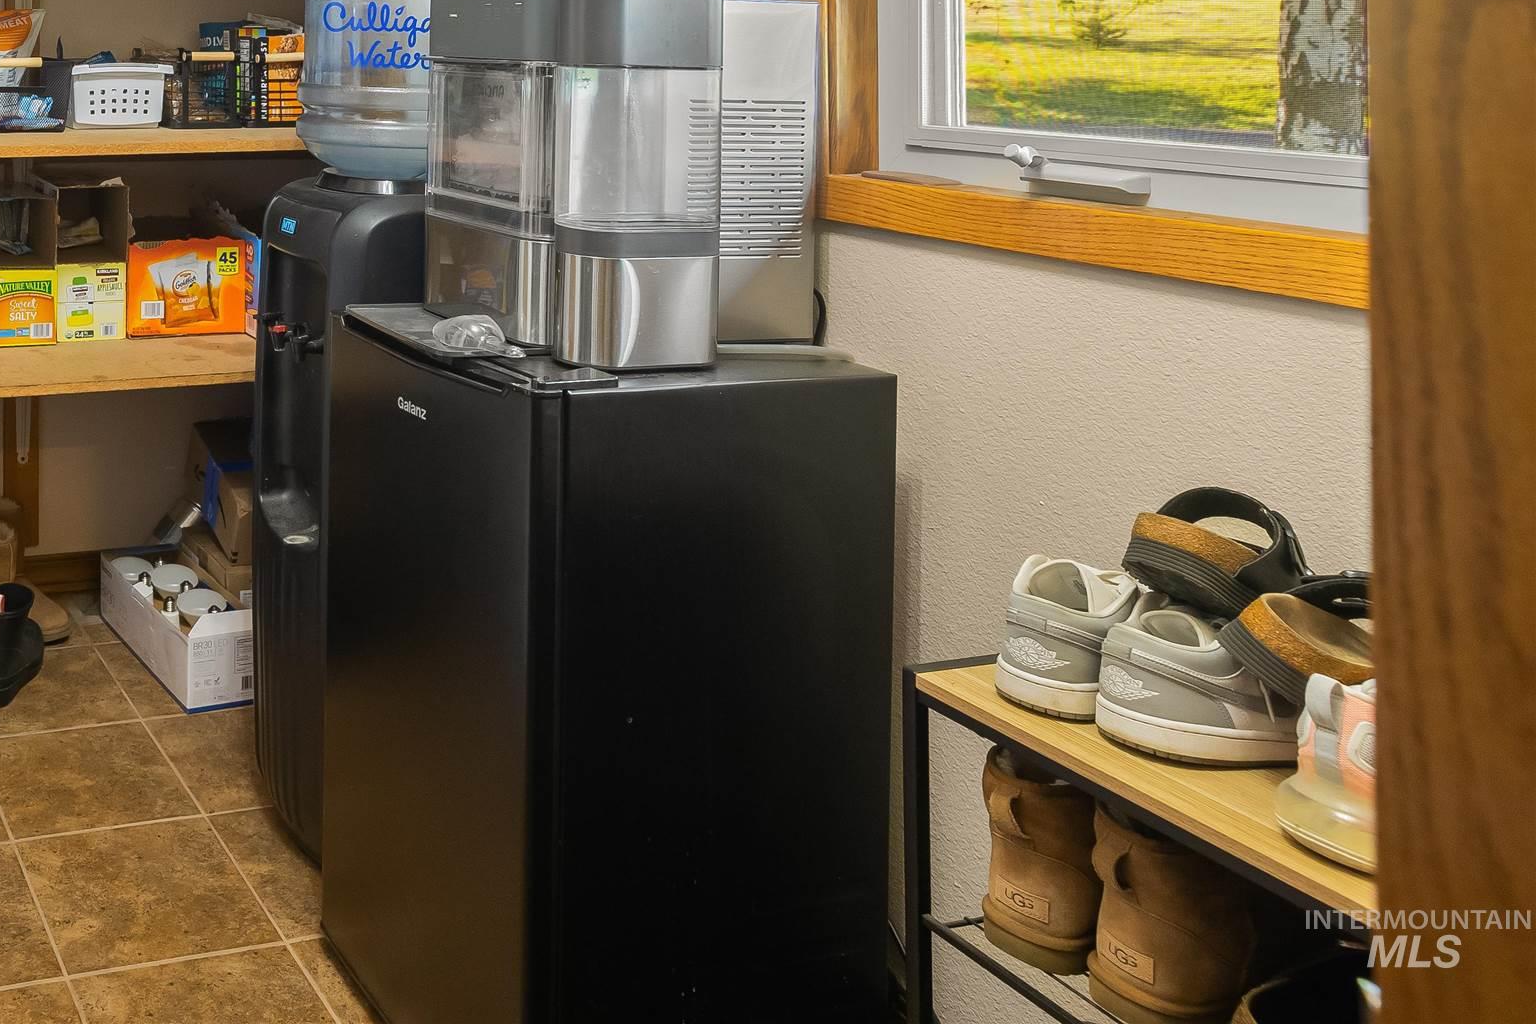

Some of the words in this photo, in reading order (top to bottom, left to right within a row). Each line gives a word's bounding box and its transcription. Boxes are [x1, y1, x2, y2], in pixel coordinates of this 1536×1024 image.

[347, 40, 433, 71] Water
[218, 252, 237, 264] 45
[25, 281, 50, 293] VALLEY
[175, 275, 197, 289] Goldfish
[9, 311, 37, 321] SALTY
[397, 396, 427, 421] Galanz
[1004, 887, 1034, 910] UGG
[1108, 942, 1138, 968] UGG
